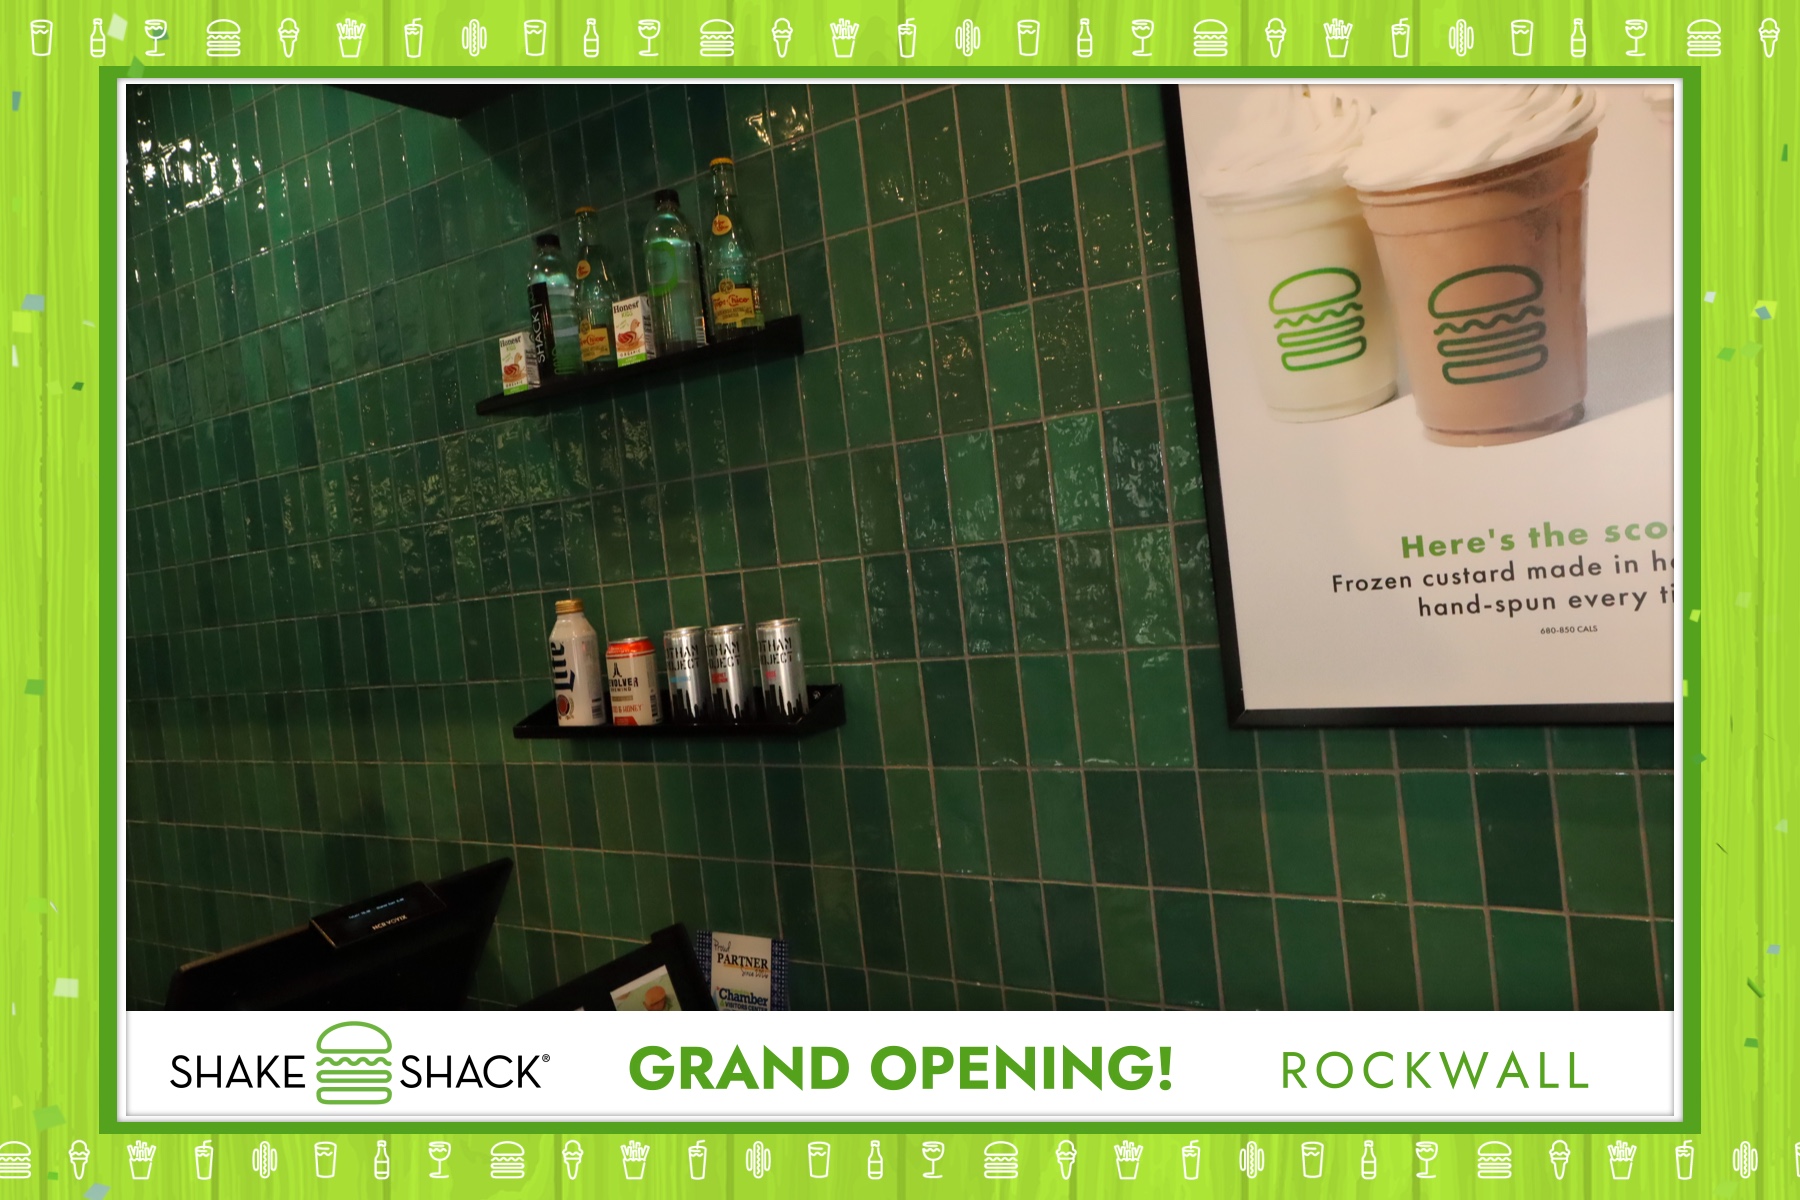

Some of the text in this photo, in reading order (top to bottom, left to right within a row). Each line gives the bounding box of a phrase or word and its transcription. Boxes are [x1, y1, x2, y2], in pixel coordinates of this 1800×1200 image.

[613, 300, 640, 314] Honest
[500, 336, 522, 348] Honest
[532, 311, 546, 364] SHACK
[1401, 521, 1674, 559] Here's the sco
[1332, 574, 1412, 593] Frozen
[1422, 560, 1515, 587] custard
[1527, 555, 1602, 580] made
[1614, 554, 1639, 574] in
[1418, 592, 1556, 618] hand-spun
[1568, 591, 1647, 612] every
[1540, 625, 1598, 635] 680-850 CALS
[709, 641, 740, 656] THAM
[713, 938, 731, 952] Proud
[717, 953, 769, 970] PARTNER
[719, 988, 769, 1006] Chamber
